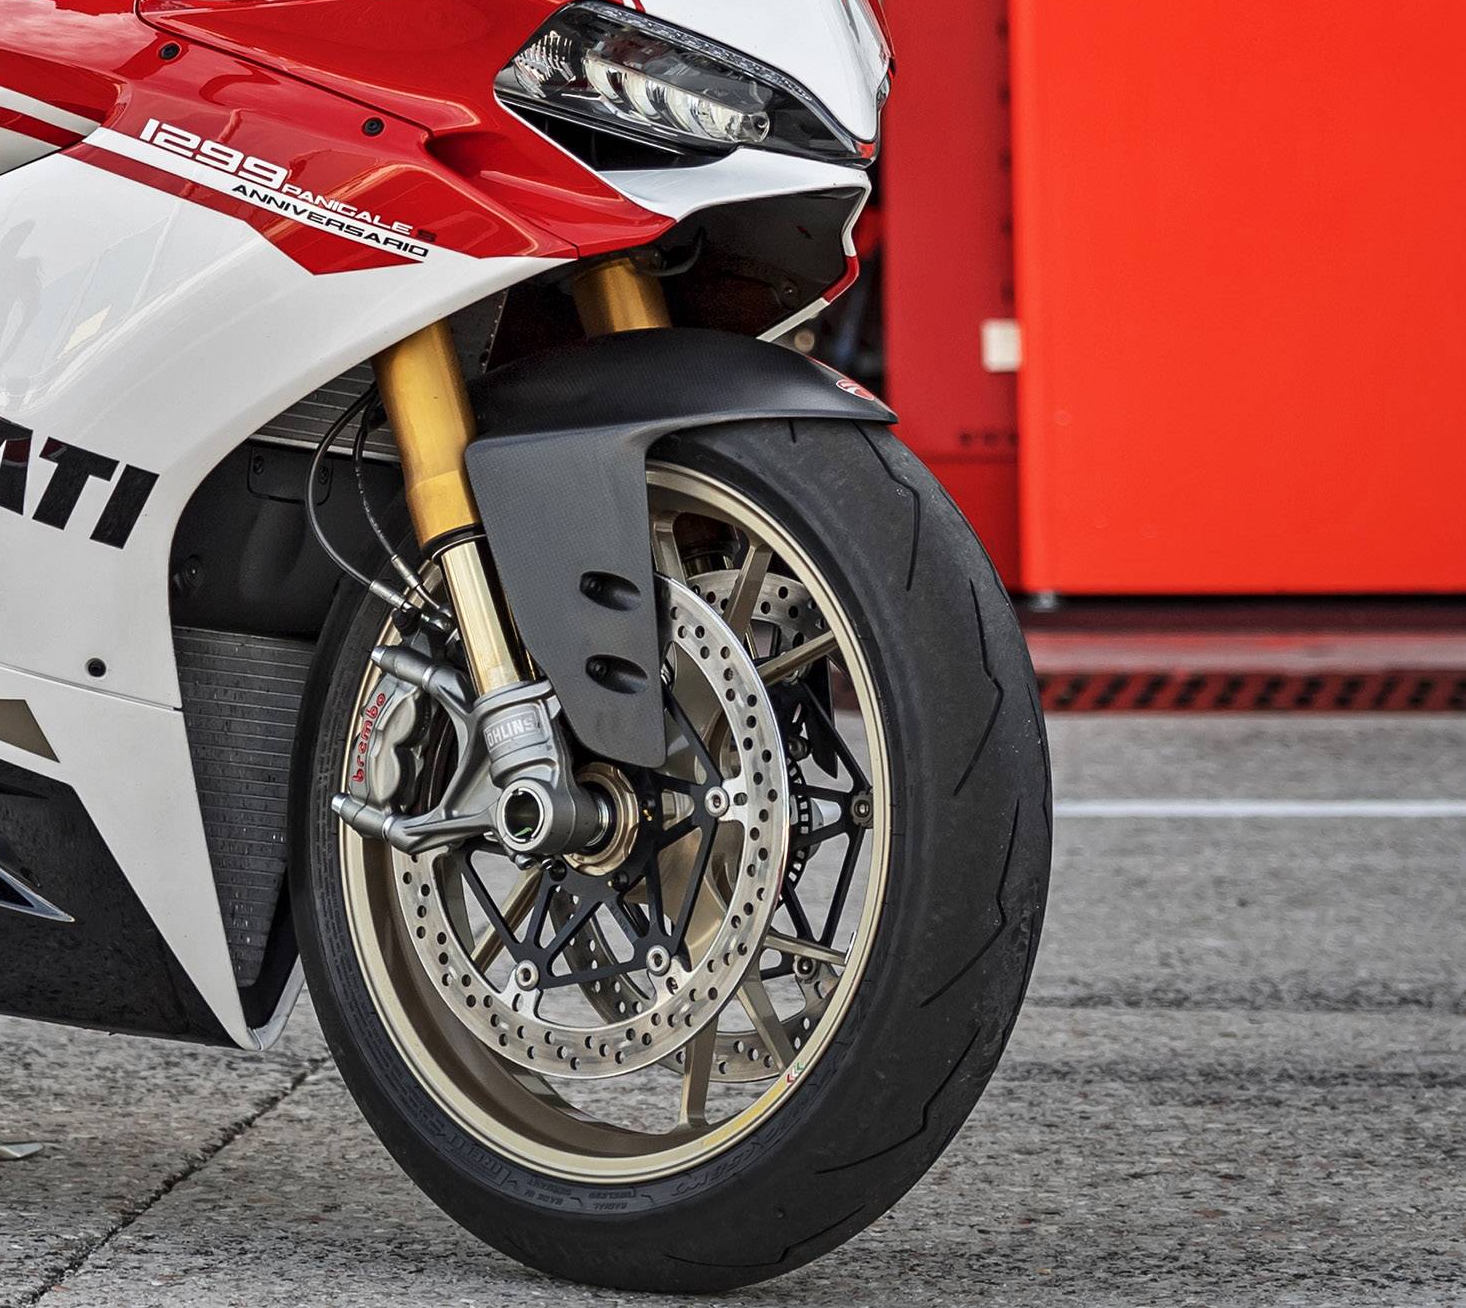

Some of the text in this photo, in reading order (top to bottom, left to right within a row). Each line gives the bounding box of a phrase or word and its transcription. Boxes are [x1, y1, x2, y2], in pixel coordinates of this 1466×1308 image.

[139, 118, 290, 190] 1299
[283, 183, 414, 236] PANIGALE
[231, 183, 430, 259] ANNIVERSARIO
[352, 692, 386, 783] brembo
